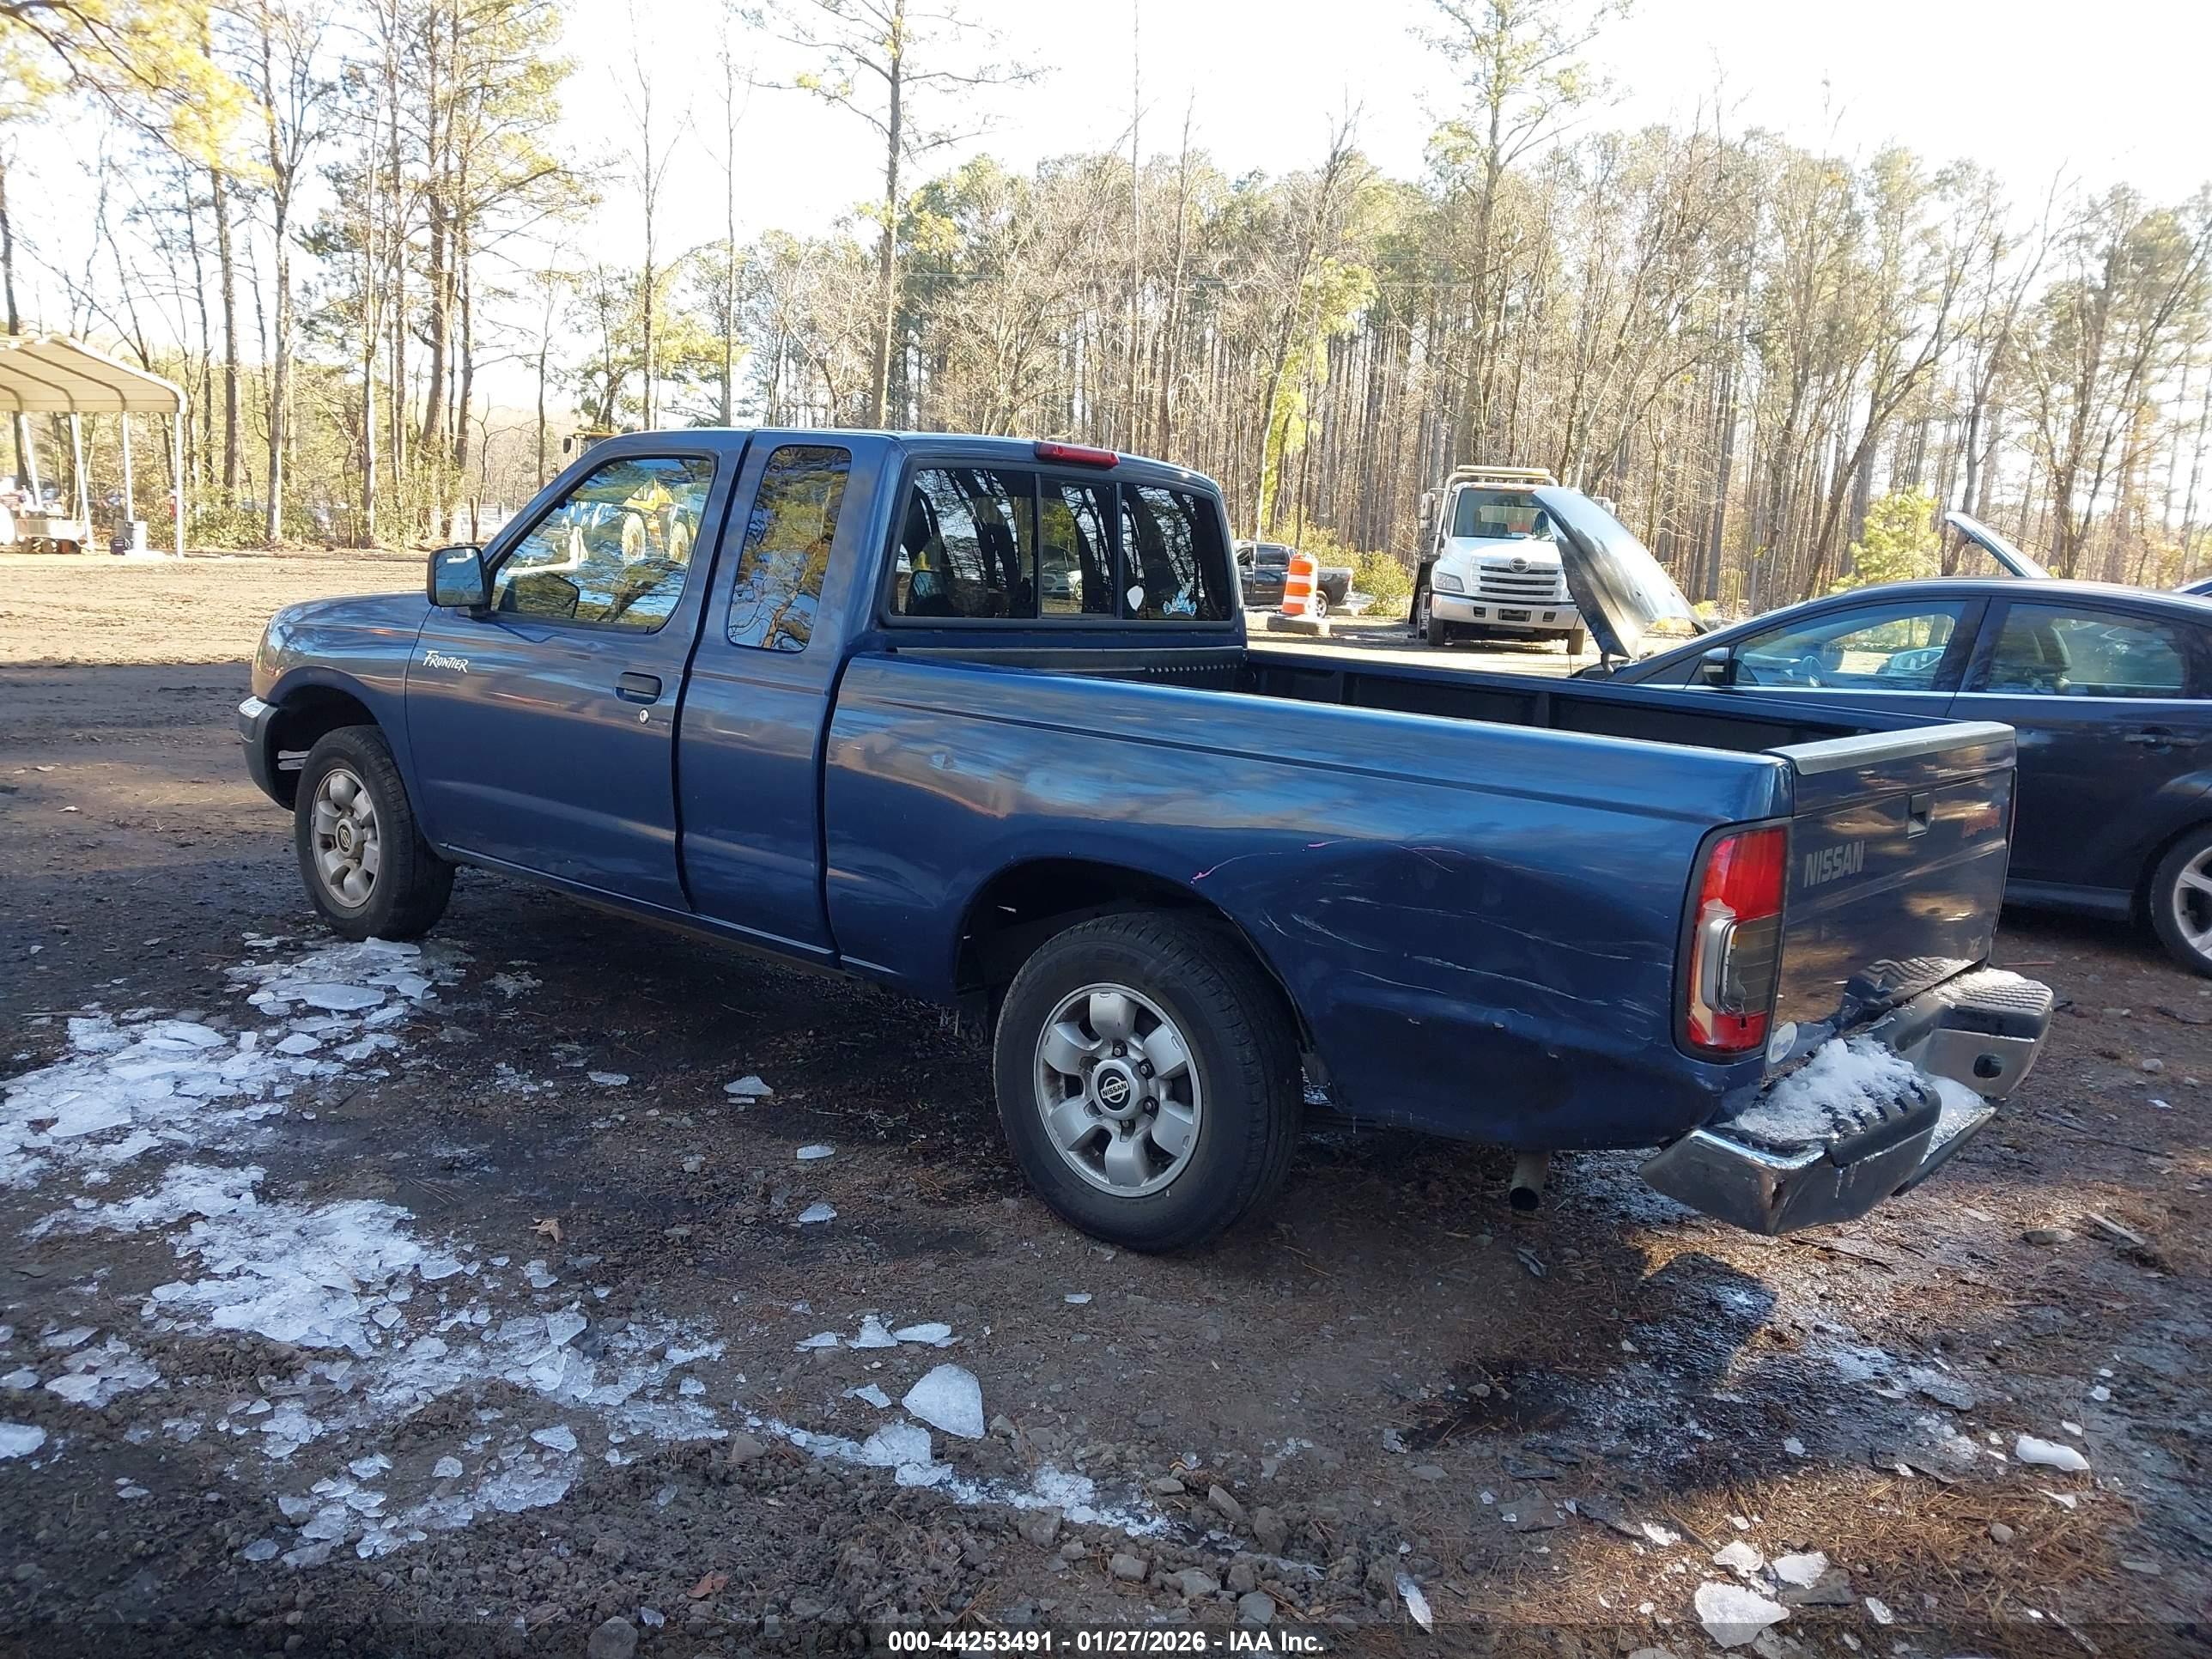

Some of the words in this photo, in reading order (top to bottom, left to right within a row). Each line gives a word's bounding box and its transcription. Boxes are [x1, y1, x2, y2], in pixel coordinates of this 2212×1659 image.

[422, 650, 469, 673] FRONTIER
[1803, 841, 1864, 888] NISSAN
[1102, 1082, 1127, 1097] NISSAN
